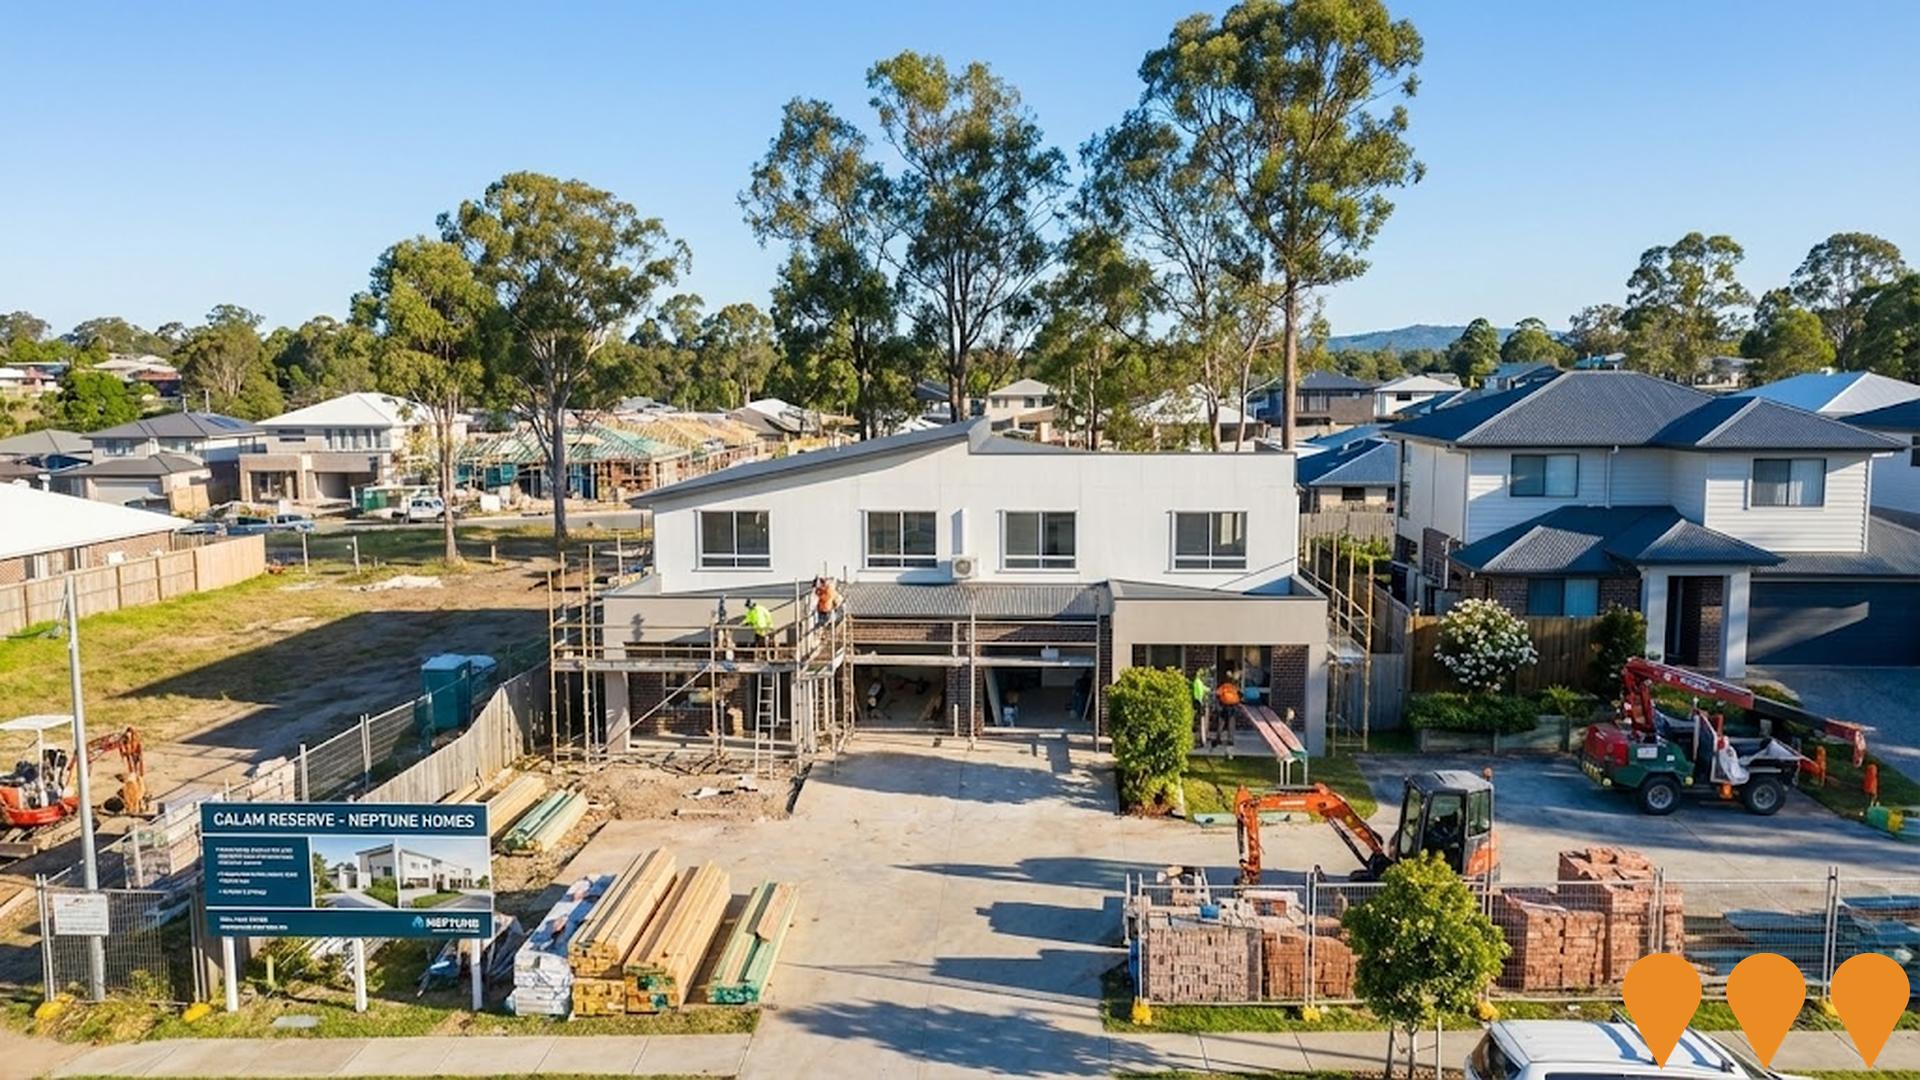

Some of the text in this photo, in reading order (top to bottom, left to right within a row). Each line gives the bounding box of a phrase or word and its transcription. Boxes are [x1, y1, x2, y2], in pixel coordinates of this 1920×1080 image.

[213, 812, 265, 826] CALAM
[269, 812, 335, 827] RESERVE
[348, 813, 419, 827] NEPTUNE
[422, 814, 475, 828] HOMES
